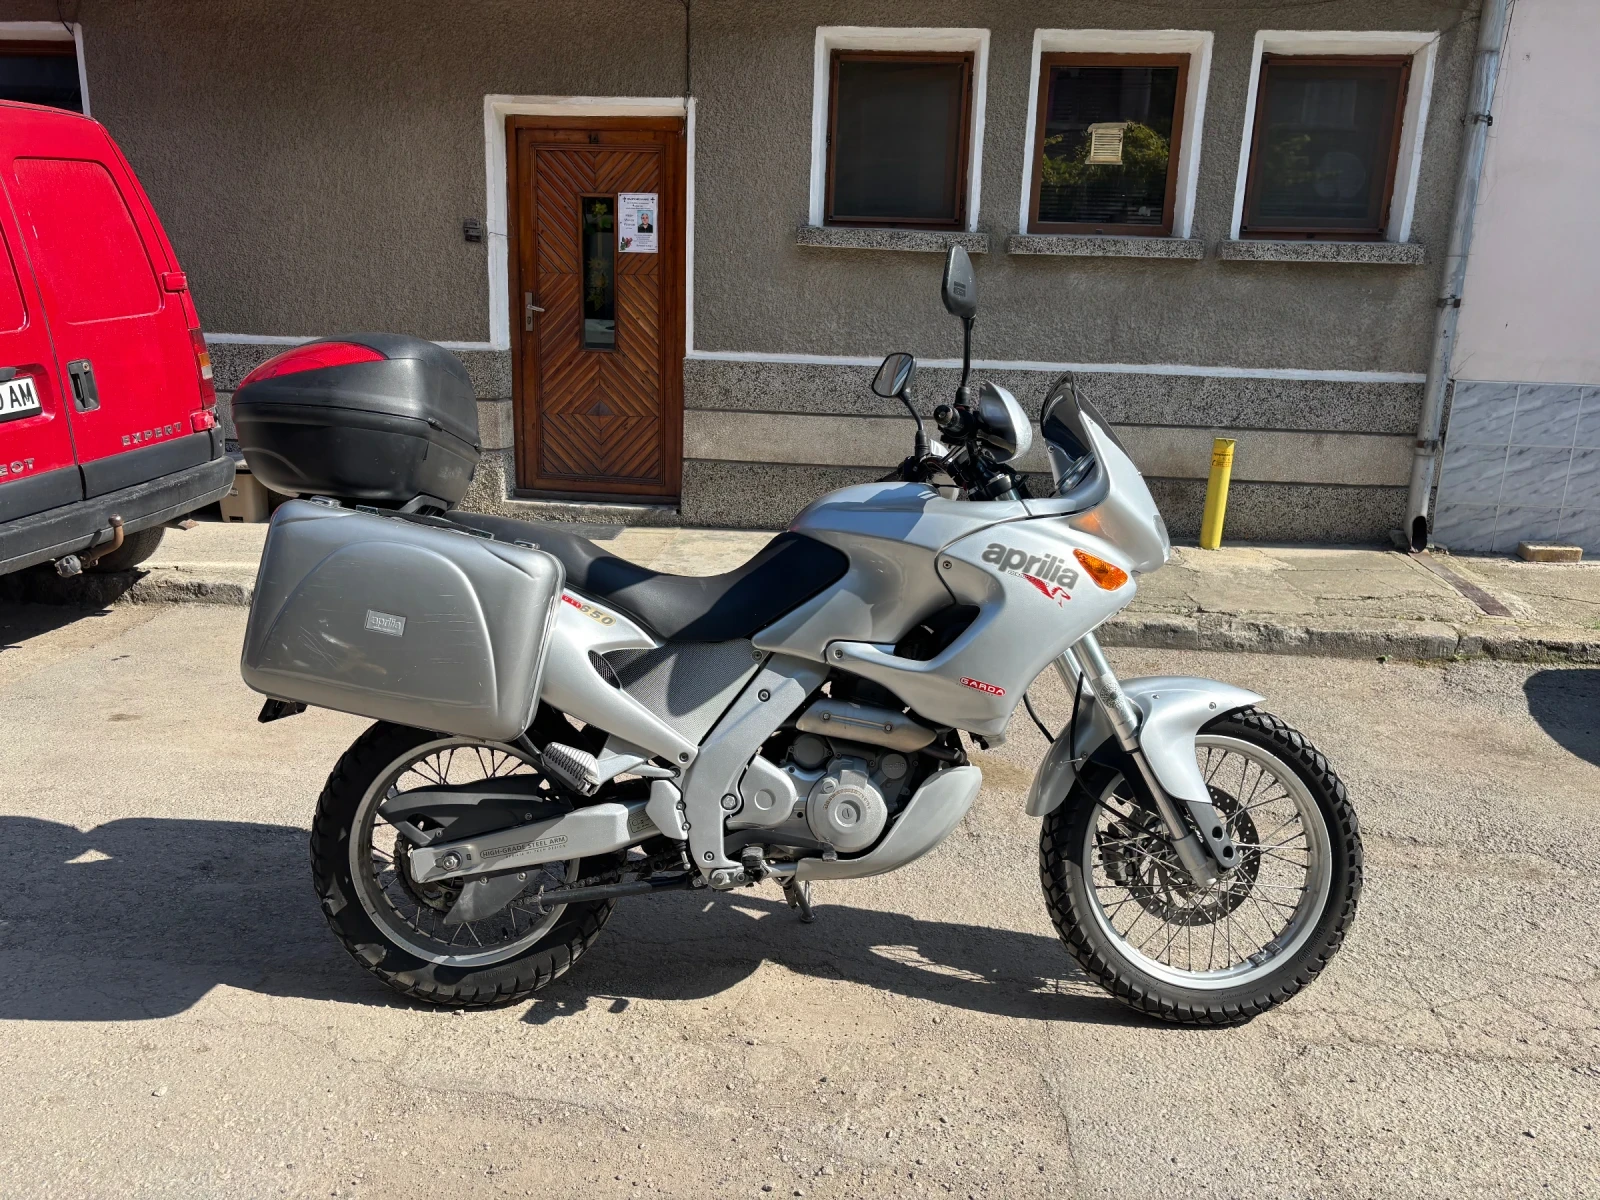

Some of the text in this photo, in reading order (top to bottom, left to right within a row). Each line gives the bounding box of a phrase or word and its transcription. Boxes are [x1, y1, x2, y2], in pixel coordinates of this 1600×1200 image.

[9, 382, 35, 409] AM
[121, 421, 182, 446] EXPERT
[981, 543, 1079, 590] aprilia
[370, 616, 402, 630] aprilia
[579, 604, 614, 625] 650
[960, 677, 1005, 696] GARDA
[482, 836, 566, 858] HIGH-GRADE STEEL ARM
